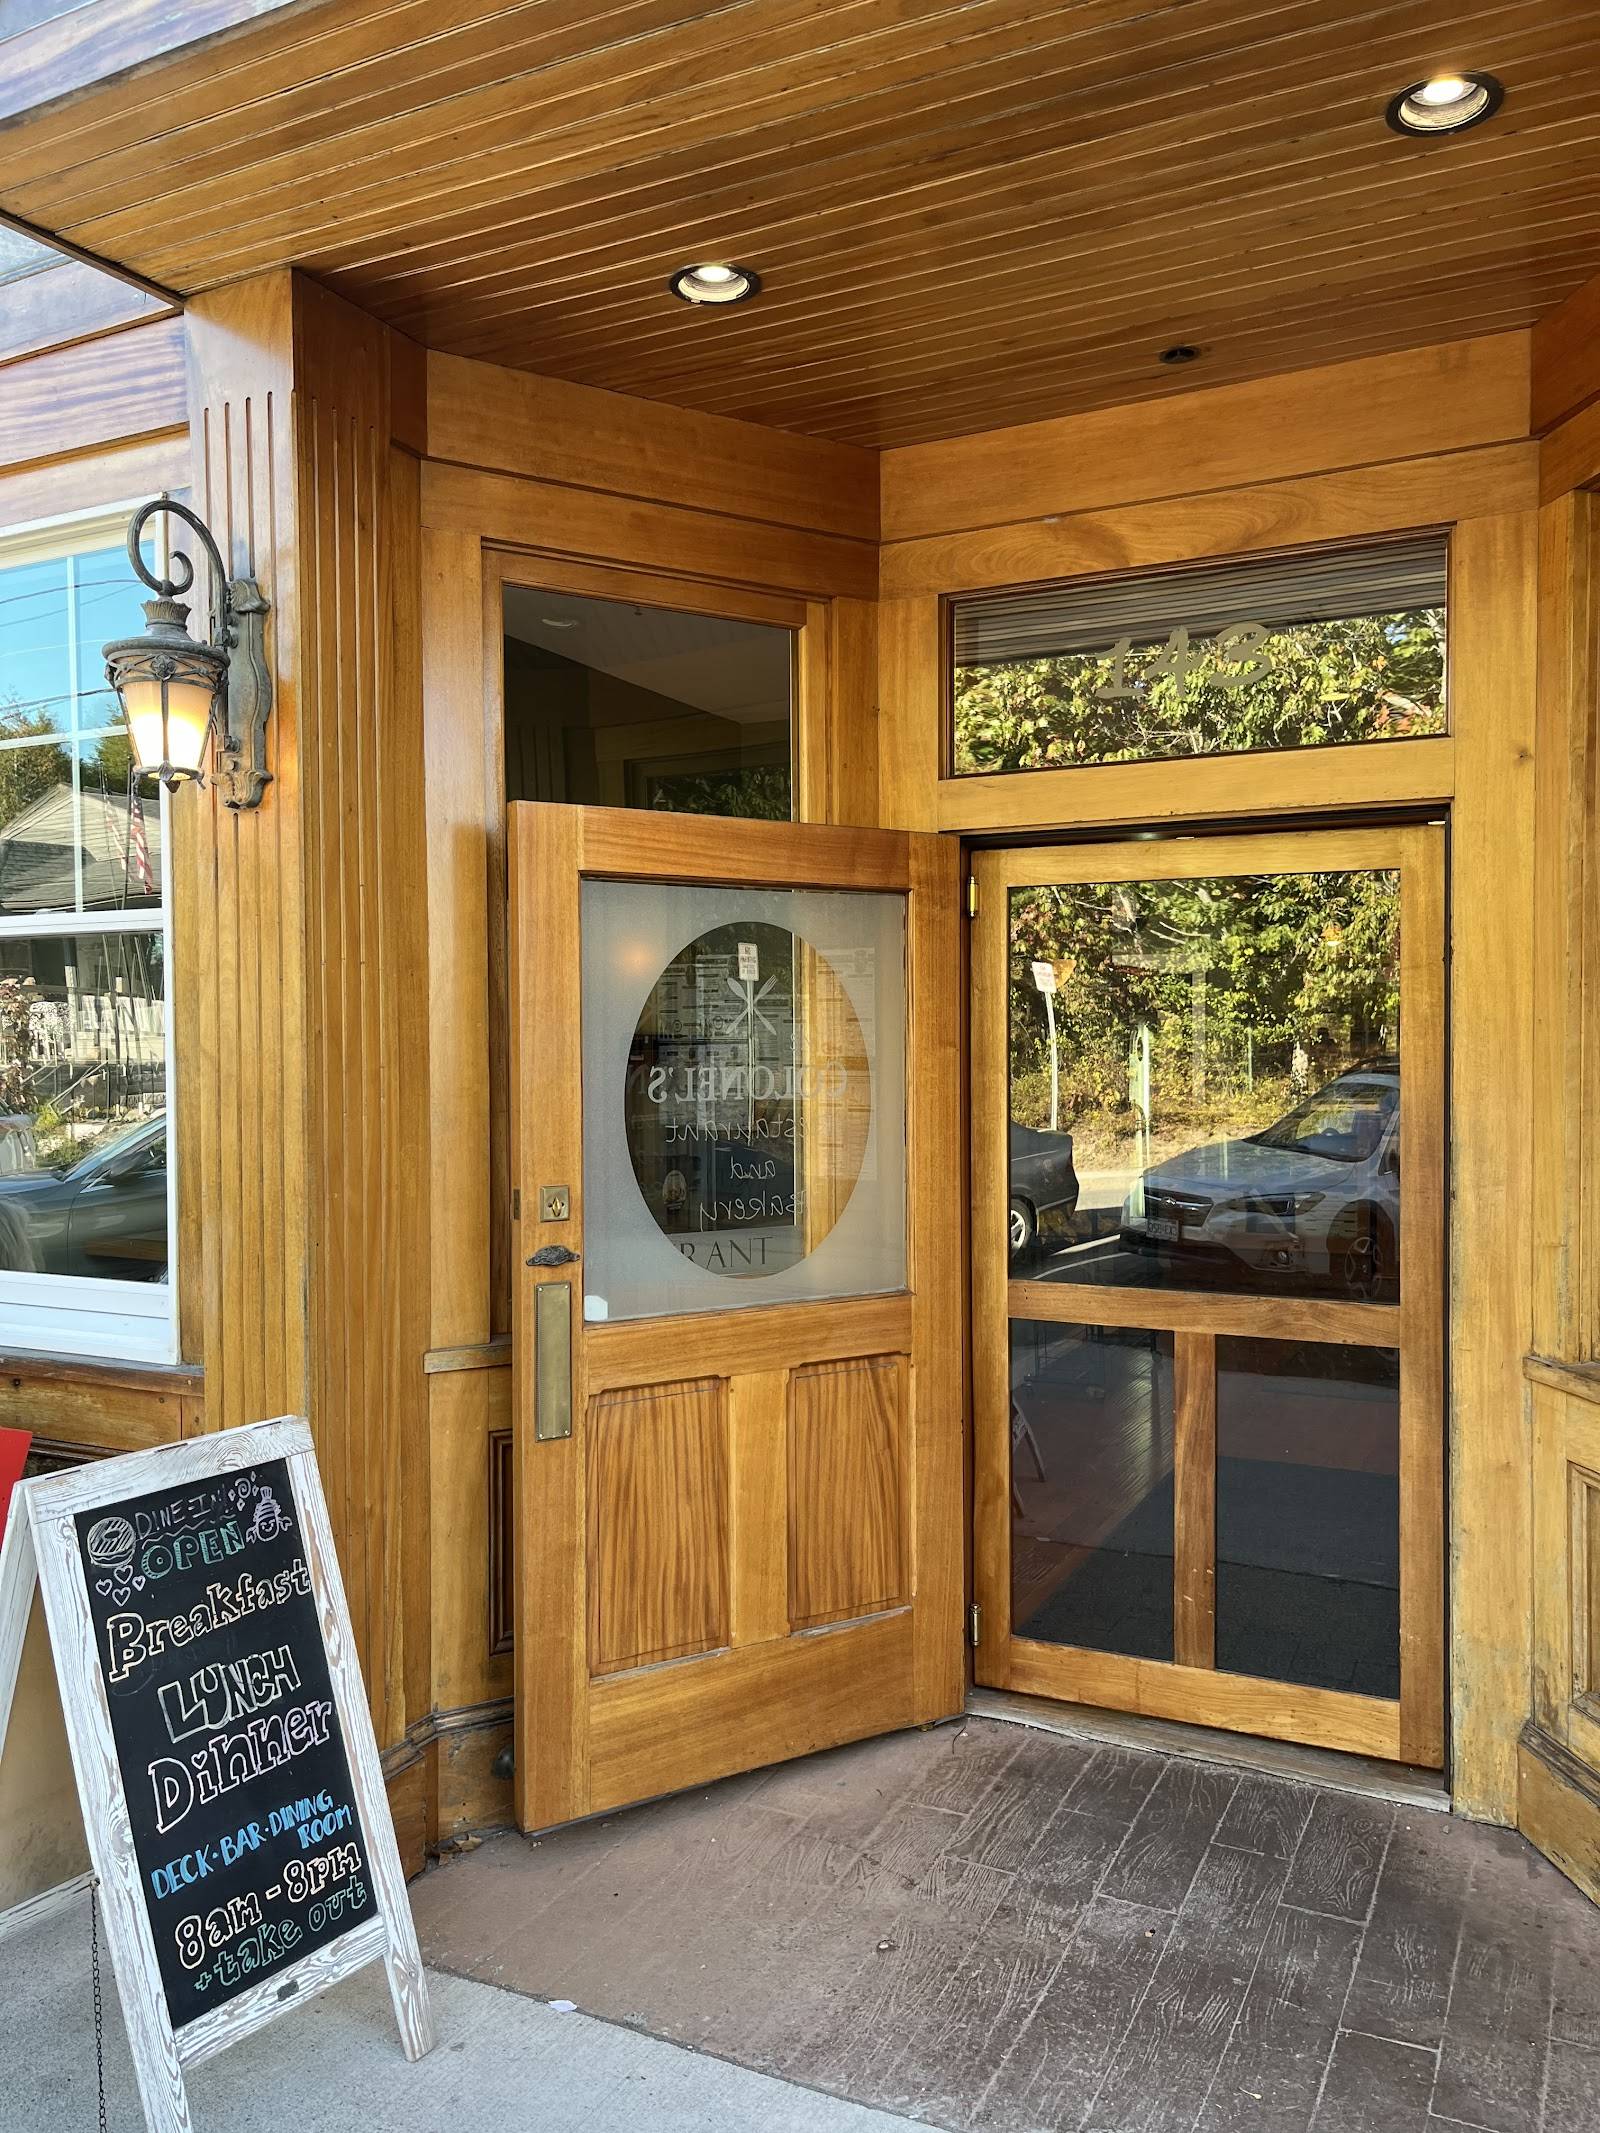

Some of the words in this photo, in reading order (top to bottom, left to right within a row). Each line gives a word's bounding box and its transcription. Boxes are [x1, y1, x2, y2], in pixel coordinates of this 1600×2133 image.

[1094, 622, 1272, 699] 143
[141, 1520, 245, 1580] OPEN
[106, 1558, 312, 1683] Breakfast
[157, 1644, 302, 1744] LUNCH
[148, 1700, 332, 1834] Dinner
[297, 1804, 353, 1850] ROOM
[308, 1875, 367, 1932] out
